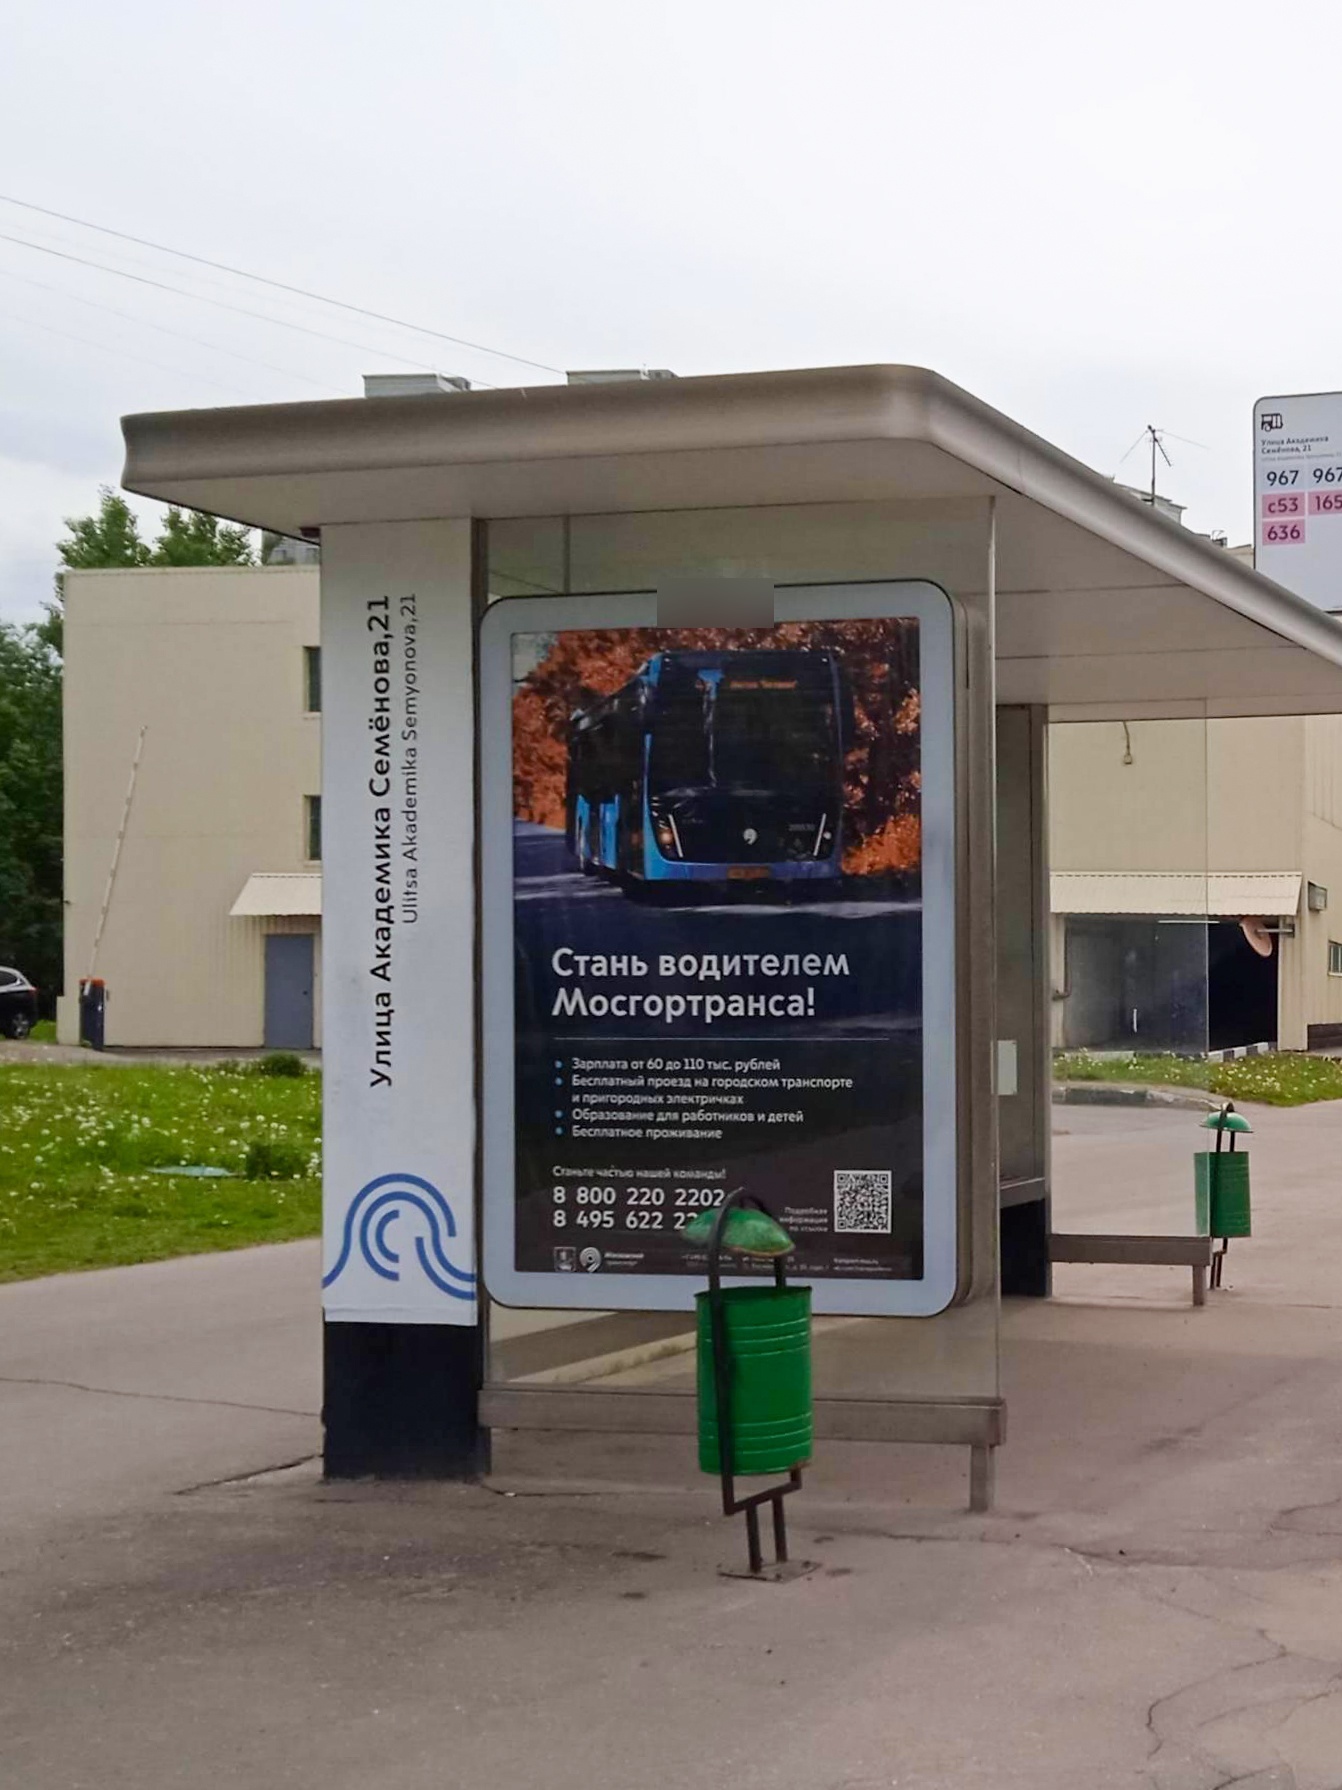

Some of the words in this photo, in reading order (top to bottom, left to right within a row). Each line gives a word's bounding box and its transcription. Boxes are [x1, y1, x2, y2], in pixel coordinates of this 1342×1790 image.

[1266, 470, 1300, 486] 967
[1267, 525, 1301, 541] 636
[401, 747, 418, 862] Akademika
[369, 807, 395, 982] Академика
[402, 868, 418, 924] Ulitsa
[551, 947, 648, 977] Стань
[658, 952, 850, 981] водителем
[551, 987, 816, 1024] Мосгортранса!
[370, 992, 395, 1088] Улица
[572, 1058, 628, 1072] Зарплата
[630, 1060, 645, 1070] от
[646, 1058, 664, 1070] 60
[665, 1060, 681, 1071] до
[683, 1058, 705, 1070] 110
[707, 1060, 732, 1070] тыс.
[734, 1058, 781, 1073] рублей
[572, 1074, 645, 1087] Бесплатный
[647, 1077, 692, 1089] проезд
[694, 1078, 709, 1087] на
[711, 1078, 779, 1090] городском
[781, 1078, 853, 1090] транспорте
[572, 1094, 580, 1103] и
[582, 1094, 664, 1106] пригородных
[666, 1094, 744, 1106] электричках
[572, 1108, 655, 1122] Образование
[656, 1111, 679, 1122] для
[682, 1109, 755, 1123] работников
[757, 1112, 765, 1121] и
[767, 1110, 804, 1123] детей
[572, 1124, 643, 1138] Бесплатное
[645, 1128, 723, 1140] проживание
[552, 1165, 594, 1177] Станьте
[596, 1167, 634, 1178] частью
[636, 1167, 671, 1178] нашей
[673, 1168, 727, 1180] команды!
[553, 1186, 567, 1204] 8
[576, 1187, 617, 1205] 800
[626, 1187, 665, 1206] 220
[674, 1188, 725, 1207] 2202
[553, 1209, 567, 1228] 8
[576, 1210, 615, 1229] 495
[625, 1211, 663, 1229] 622
